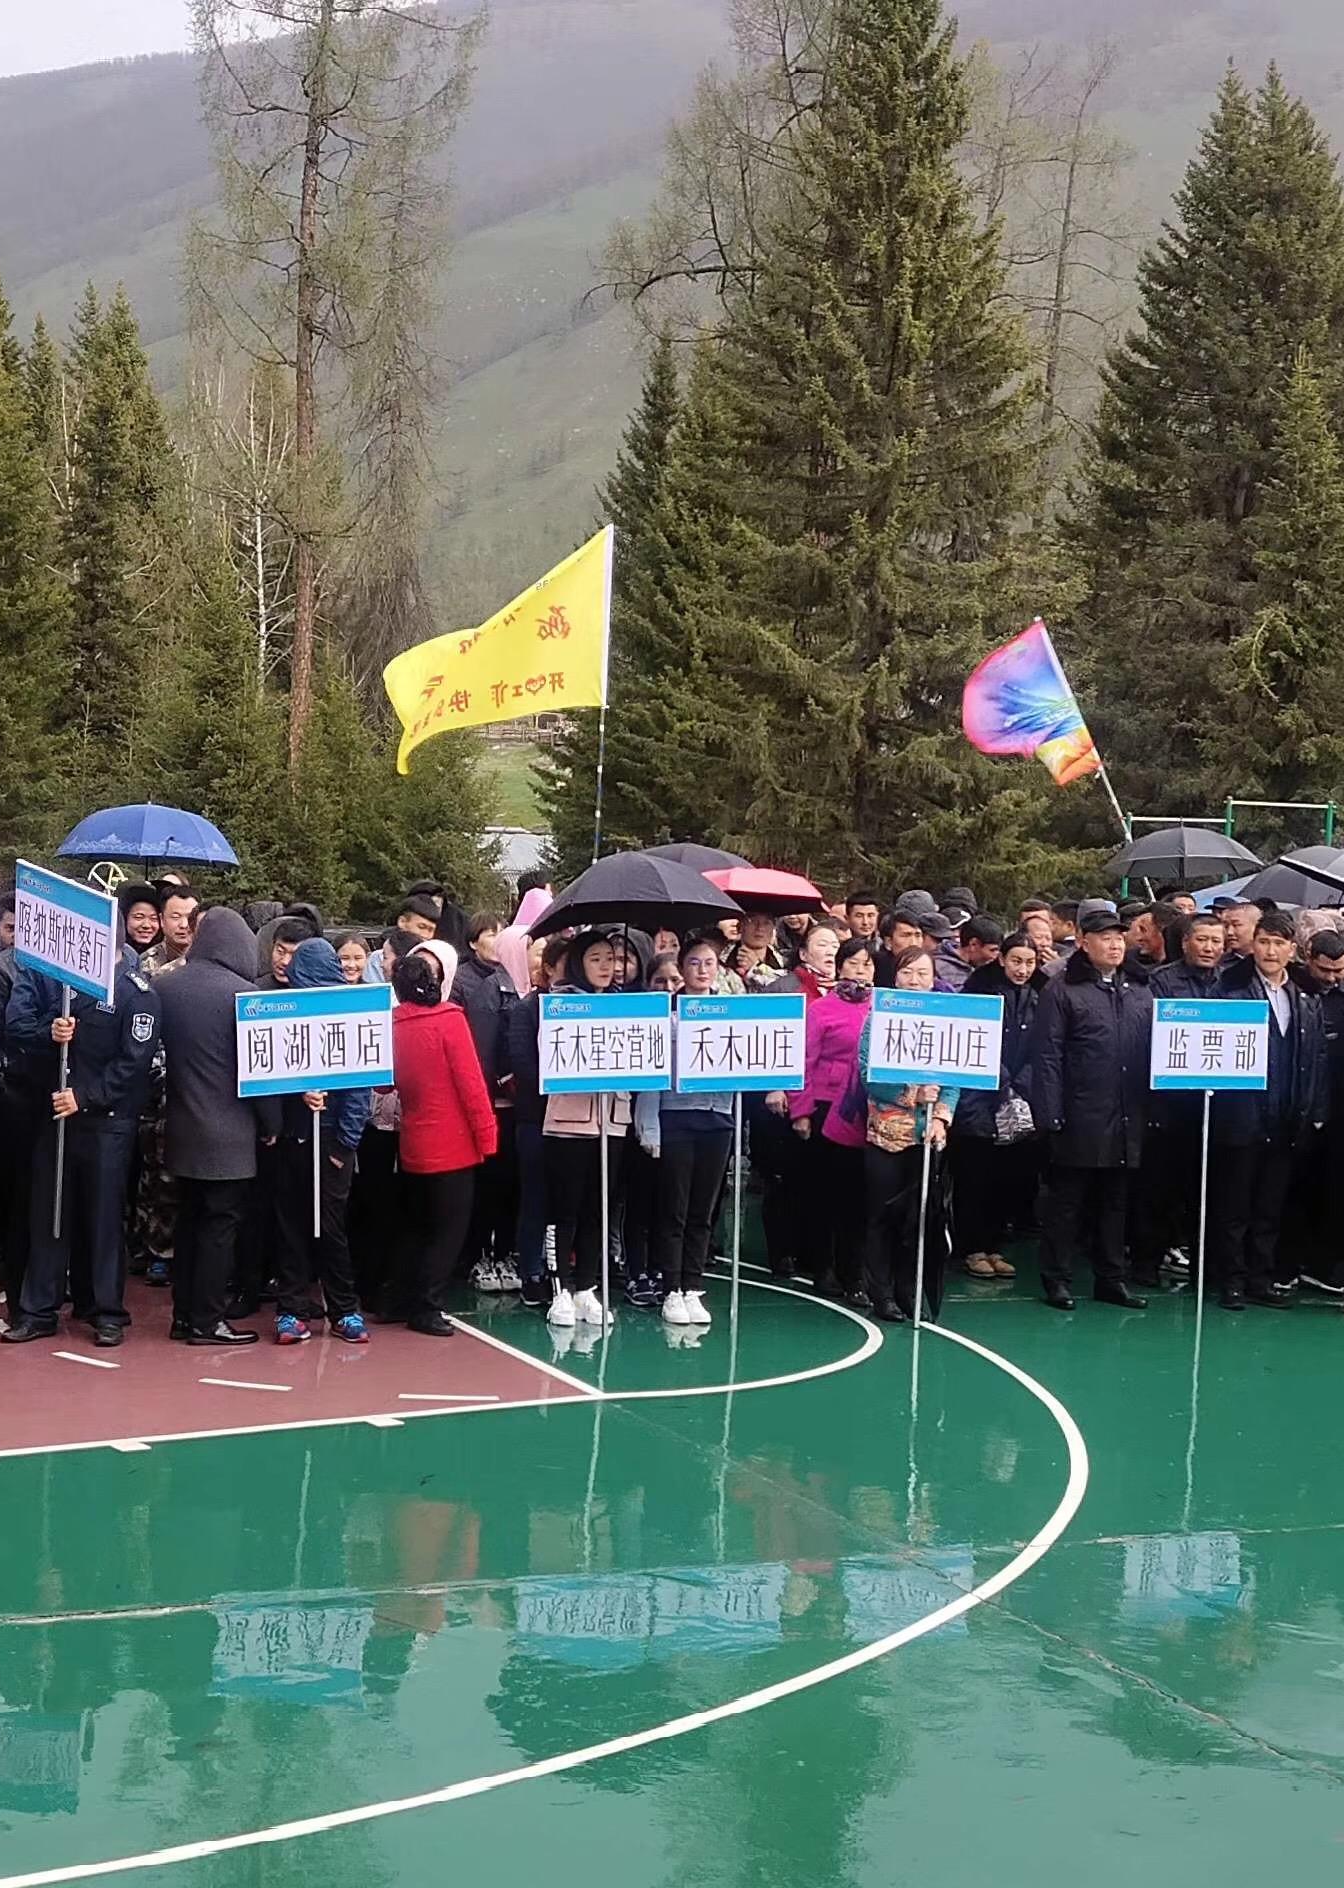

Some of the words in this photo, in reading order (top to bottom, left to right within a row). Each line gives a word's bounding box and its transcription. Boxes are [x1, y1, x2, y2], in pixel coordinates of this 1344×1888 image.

[17, 899, 109, 981] 喀纳斯快餐厅
[246, 1018, 383, 1076] 阅湖酒店
[548, 1024, 665, 1073] 禾木星空营地
[690, 1026, 795, 1072] 禾木山庄
[884, 1019, 989, 1071] 林海山庄
[1166, 1028, 1258, 1071] 监票部
